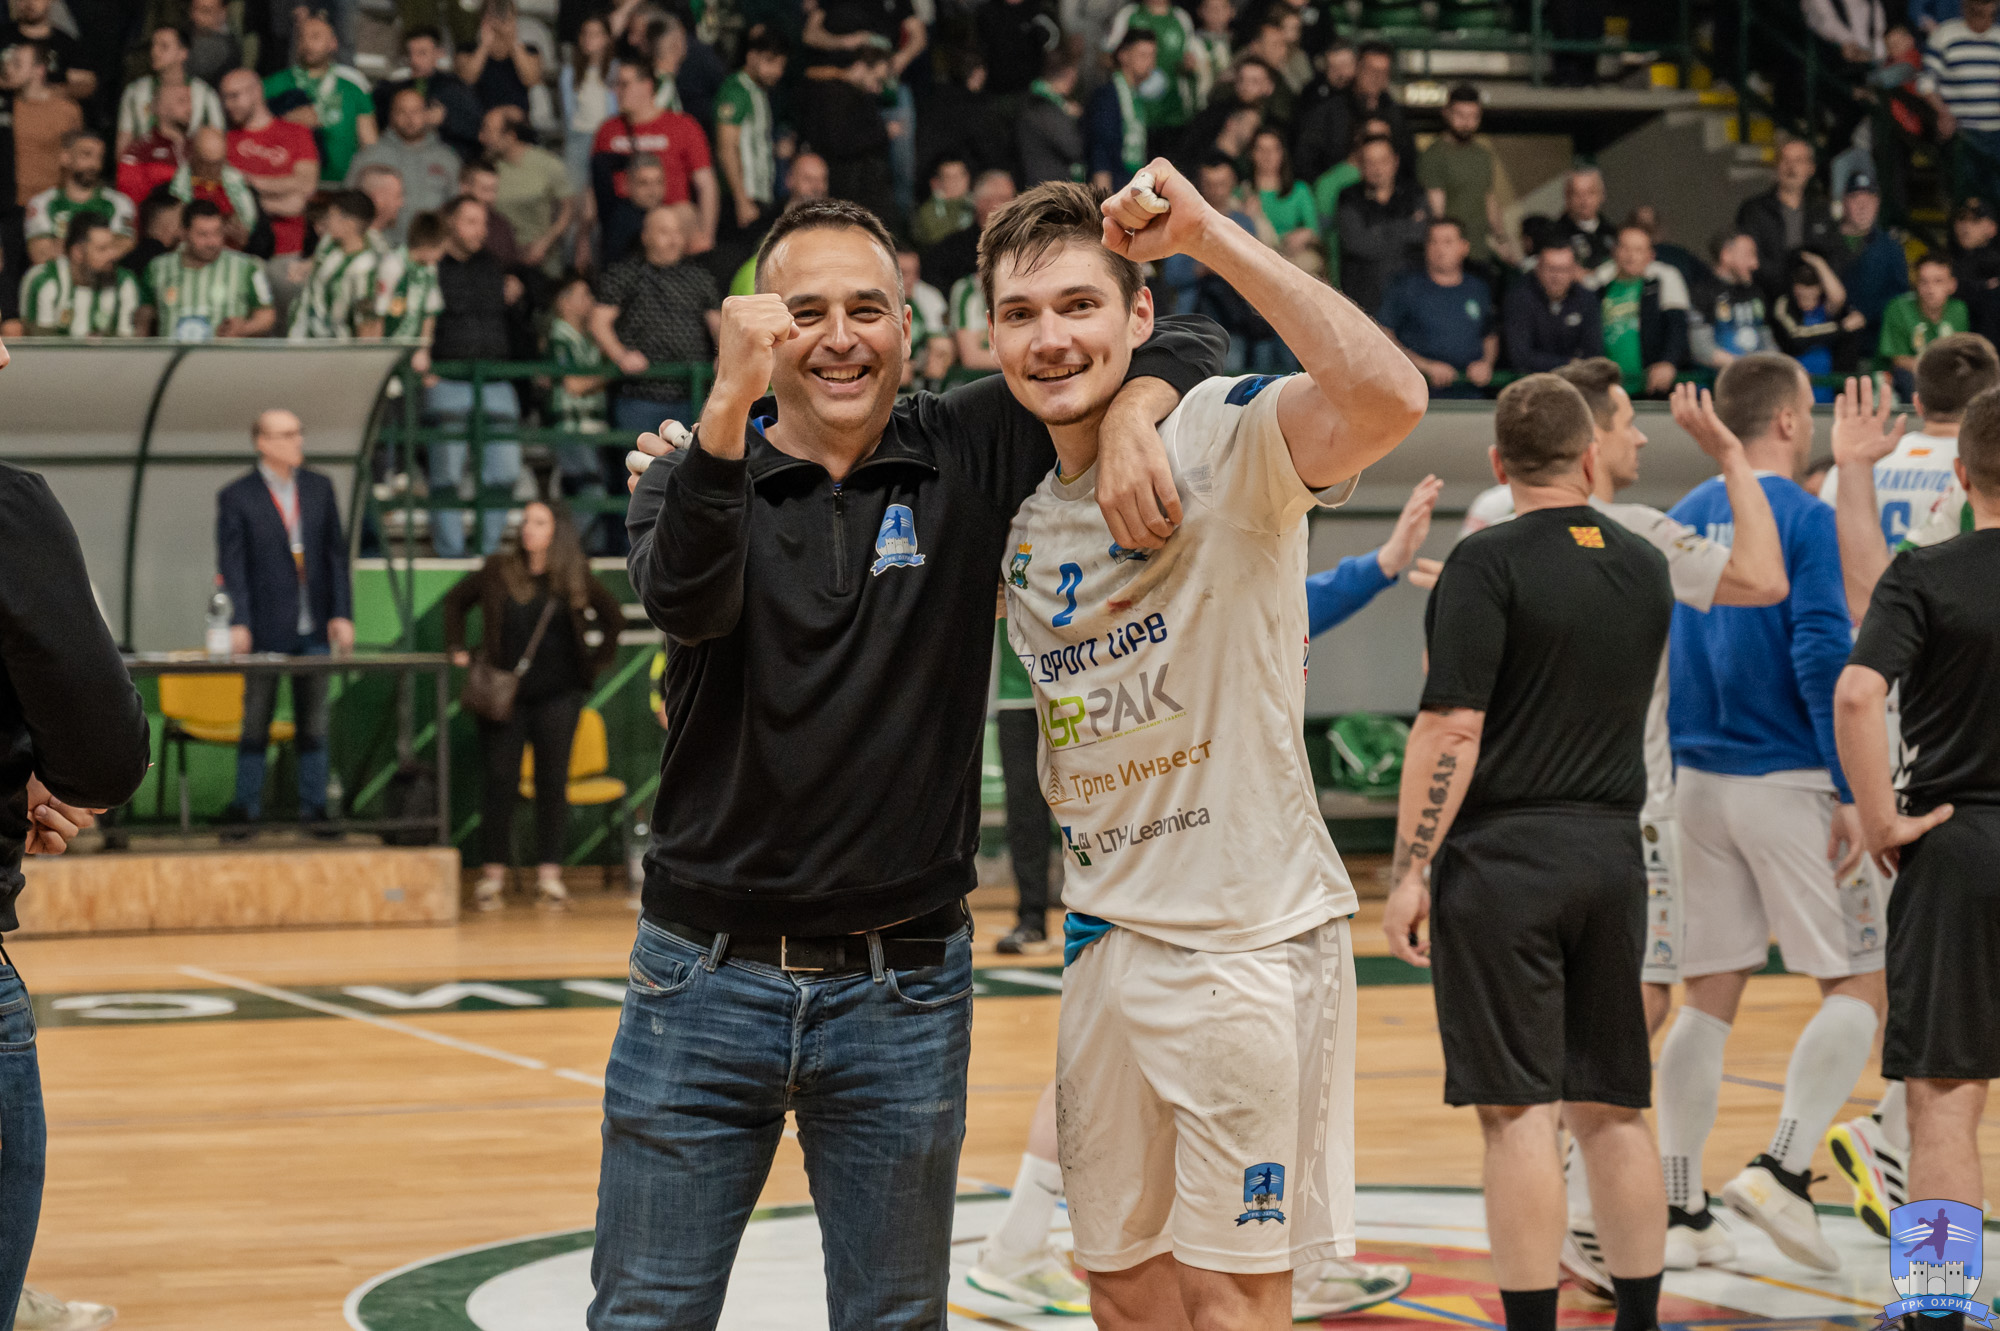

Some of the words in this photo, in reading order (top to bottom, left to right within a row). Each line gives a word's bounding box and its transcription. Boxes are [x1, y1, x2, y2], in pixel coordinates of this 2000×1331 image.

[1873, 468, 1951, 492] ANKOVIC
[1052, 562, 1083, 628] 2
[1038, 637, 1098, 683] SPORT
[1069, 773, 1117, 805] Трпе
[1117, 739, 1212, 787] Инвест
[1129, 807, 1211, 846] Learnica
[1409, 752, 1457, 859] DRAGAN
